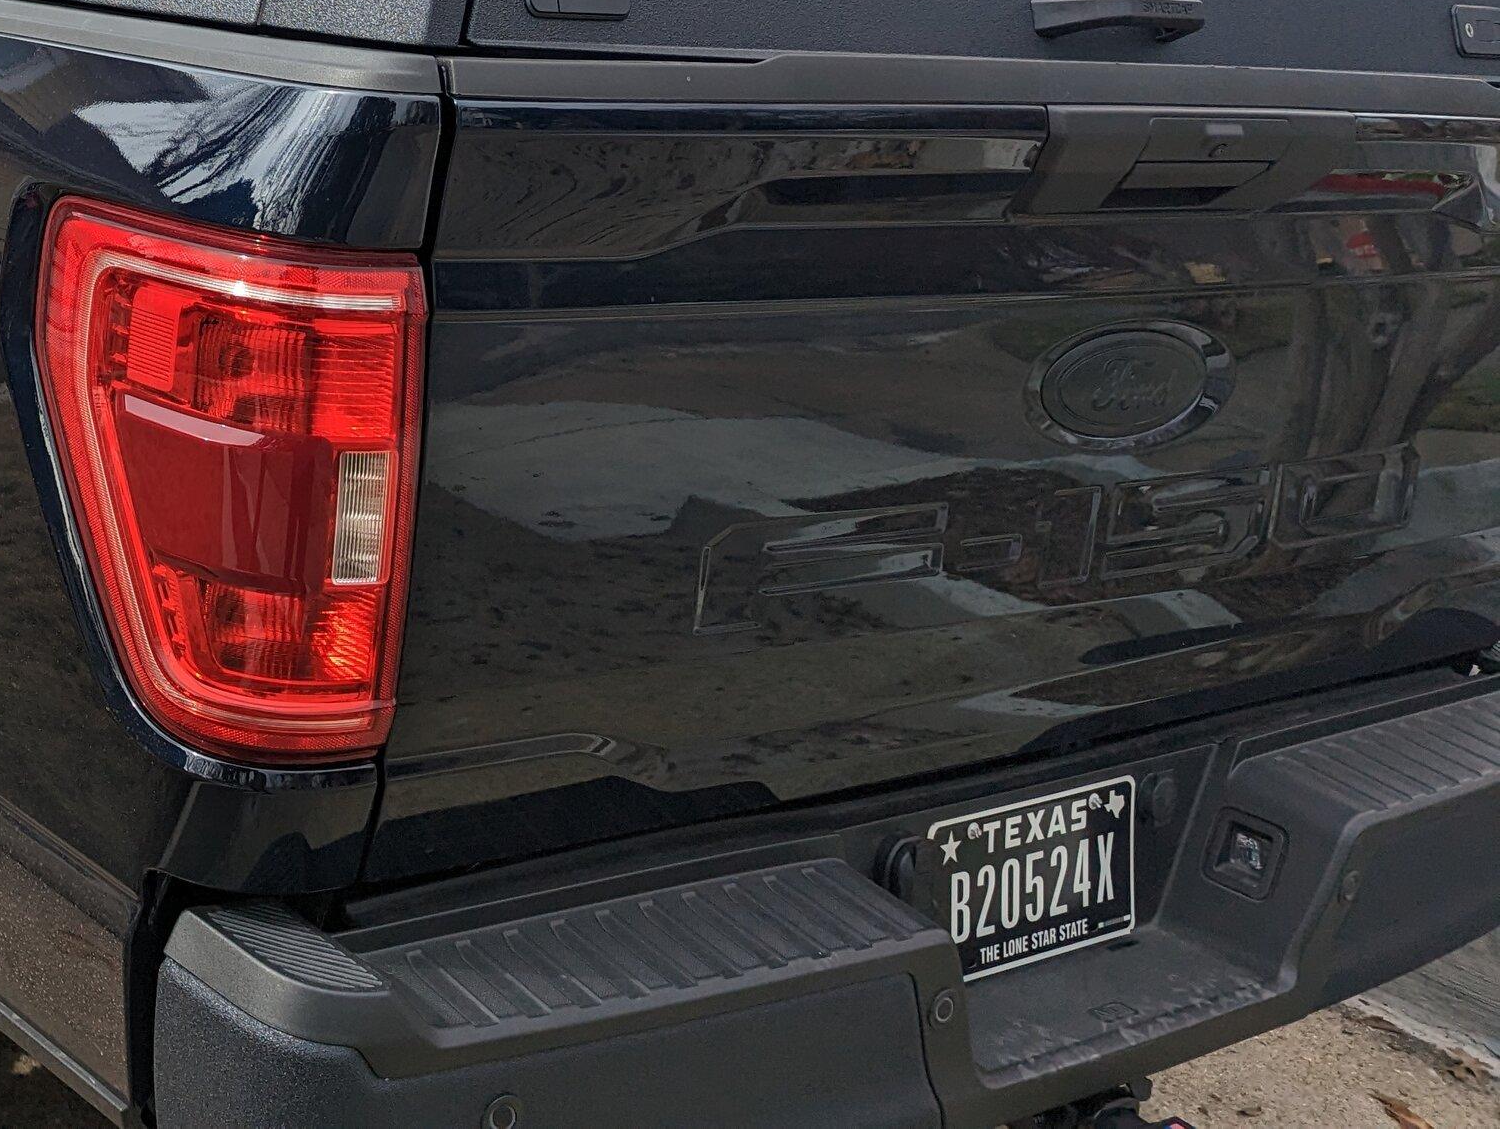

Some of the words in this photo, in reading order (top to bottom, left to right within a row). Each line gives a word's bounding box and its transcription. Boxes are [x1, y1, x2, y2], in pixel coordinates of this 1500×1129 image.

[693, 441, 1422, 636] F-150
[983, 799, 1088, 853] TEXAS
[950, 831, 1115, 944] B20524X
[980, 943, 1000, 965] THE
[1003, 934, 1029, 958] LONE
[1031, 926, 1057, 949] STAR
[1059, 918, 1088, 941] STATE
